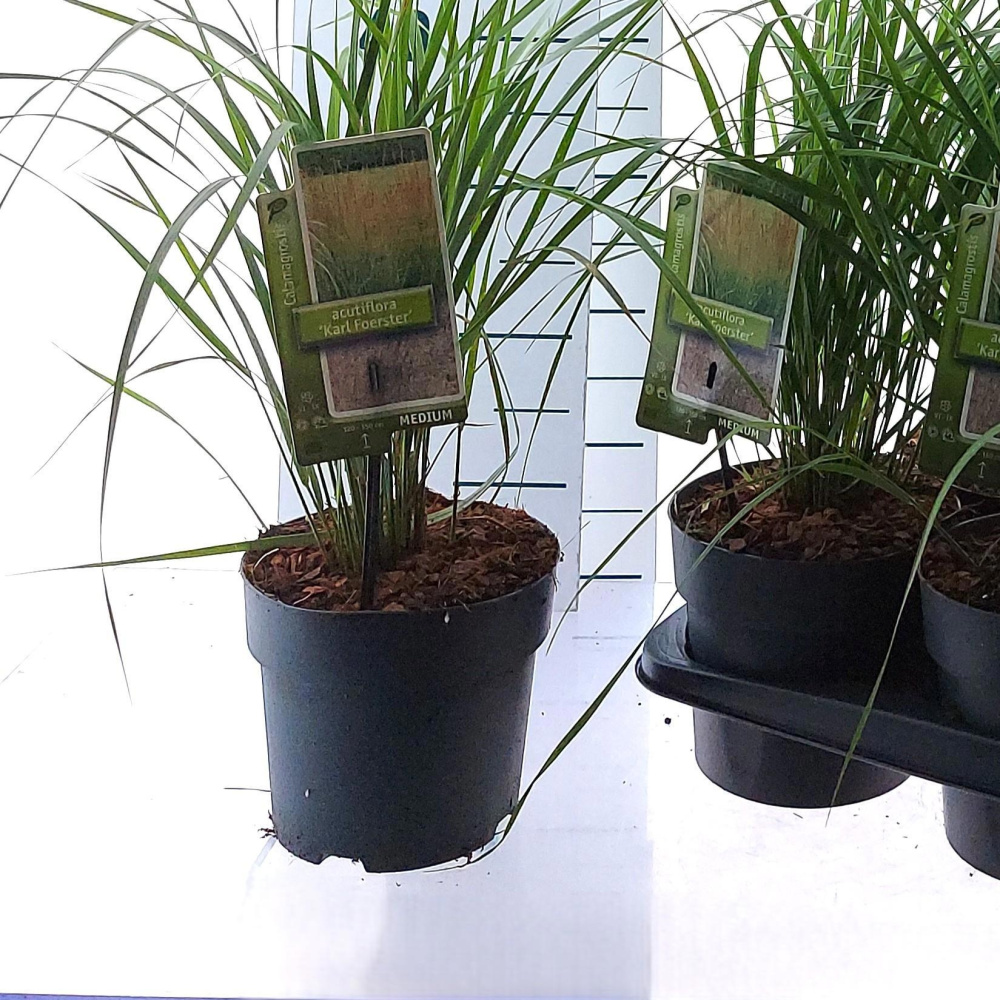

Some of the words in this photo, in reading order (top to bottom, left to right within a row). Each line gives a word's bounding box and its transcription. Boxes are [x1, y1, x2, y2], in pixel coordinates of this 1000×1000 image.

[956, 234, 979, 315] Calamagrostis
[332, 299, 397, 321] acutiflora
[696, 302, 745, 327] cutiflora
[399, 408, 453, 426] MEDIUM
